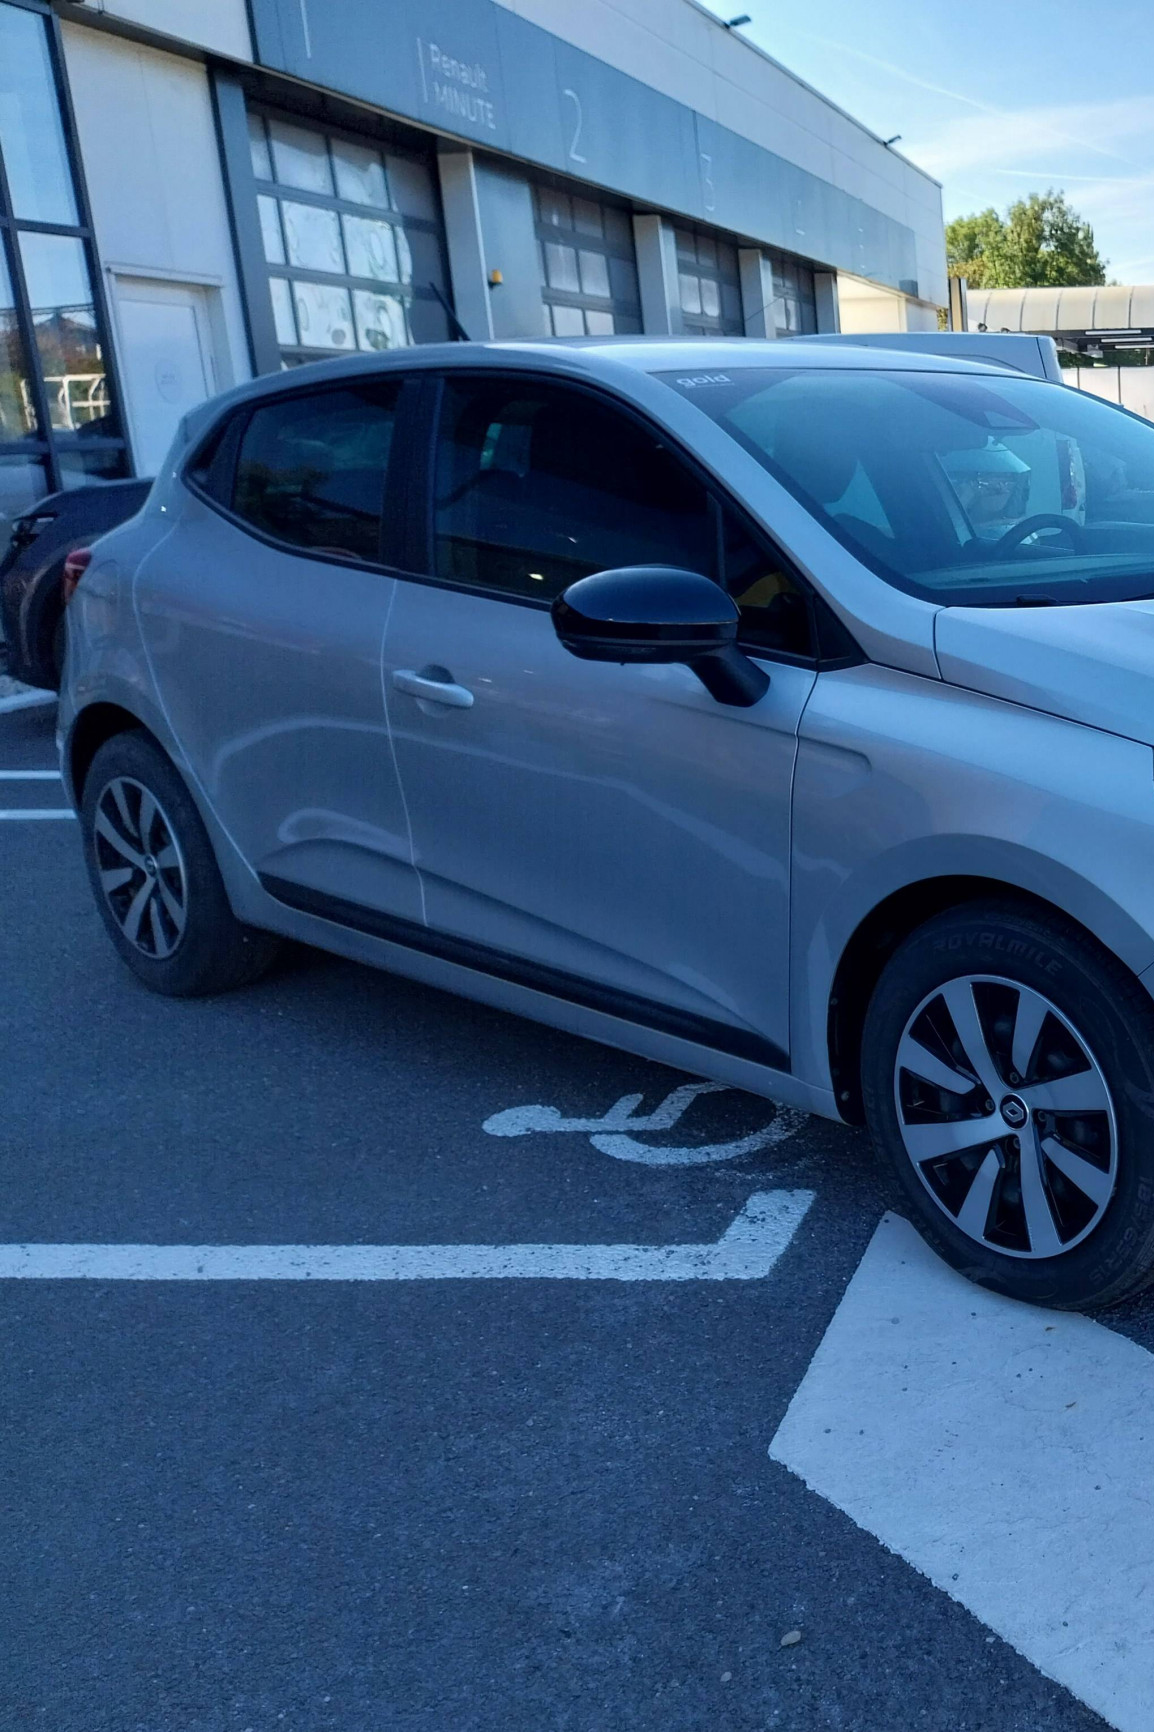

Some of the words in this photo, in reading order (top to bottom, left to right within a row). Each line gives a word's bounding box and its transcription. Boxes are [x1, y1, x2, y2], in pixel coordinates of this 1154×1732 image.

[429, 42, 490, 93] Renault
[433, 81, 496, 130] MINUTE
[564, 88, 587, 164] 2
[676, 374, 731, 389] gold
